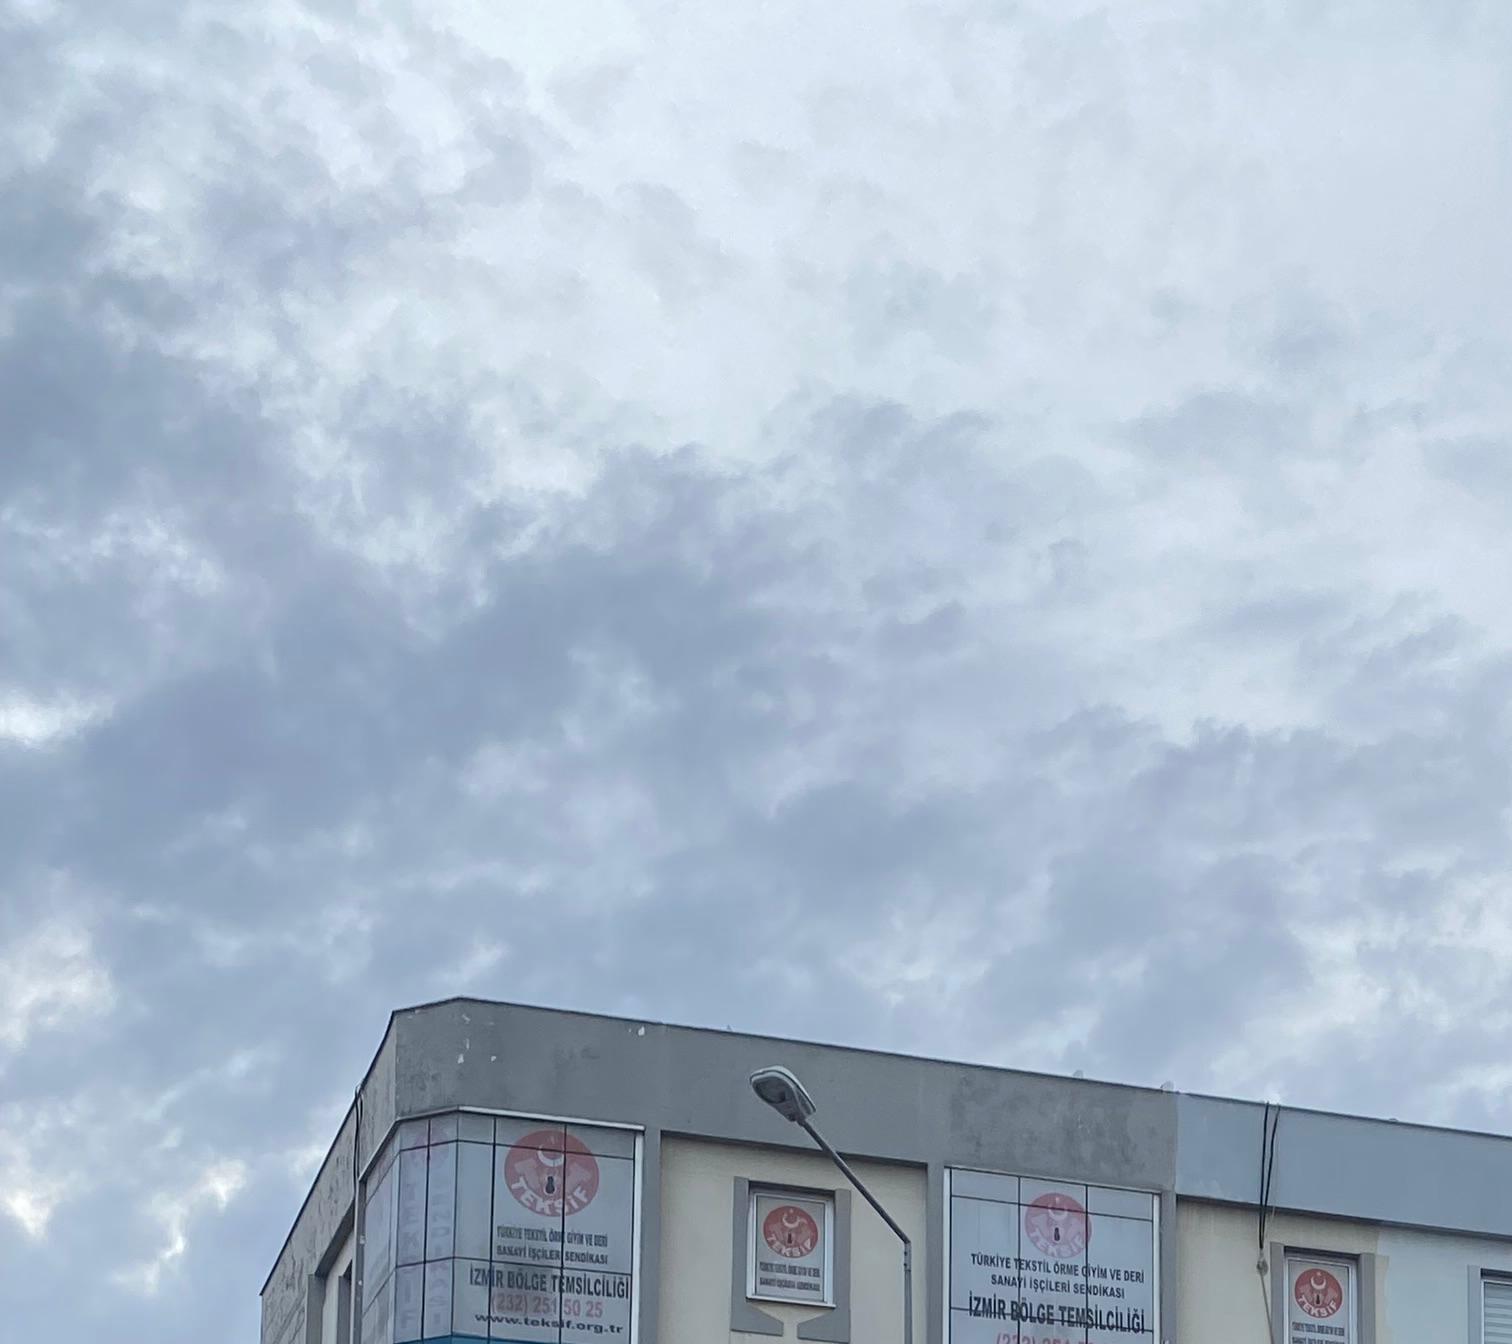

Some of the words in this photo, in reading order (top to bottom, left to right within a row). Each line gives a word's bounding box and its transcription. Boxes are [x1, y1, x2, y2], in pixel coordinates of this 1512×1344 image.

[510, 1176, 592, 1217] TEKSİF
[470, 1266, 504, 1288] İZMİR
[507, 1268, 547, 1292] BÖLGE
[551, 1271, 629, 1299] TEMSİLCİLİĞİ
[971, 1252, 1011, 1269] TÜRKİYE
[1013, 1257, 1051, 1274] TEKSTİL
[1054, 1260, 1079, 1277] ÖRME
[1110, 1269, 1121, 1281] VE
[1123, 1269, 1145, 1284] DERİ
[1073, 1284, 1125, 1299] SENDİKASI
[475, 1313, 623, 1334] www.teksif.org.tr
[586, 1301, 603, 1319] 25
[969, 1291, 1007, 1320] İZMİR
[1011, 1297, 1055, 1326] BÖLGE
[1058, 1304, 1145, 1334] TEMSİLCİLİĞİ
